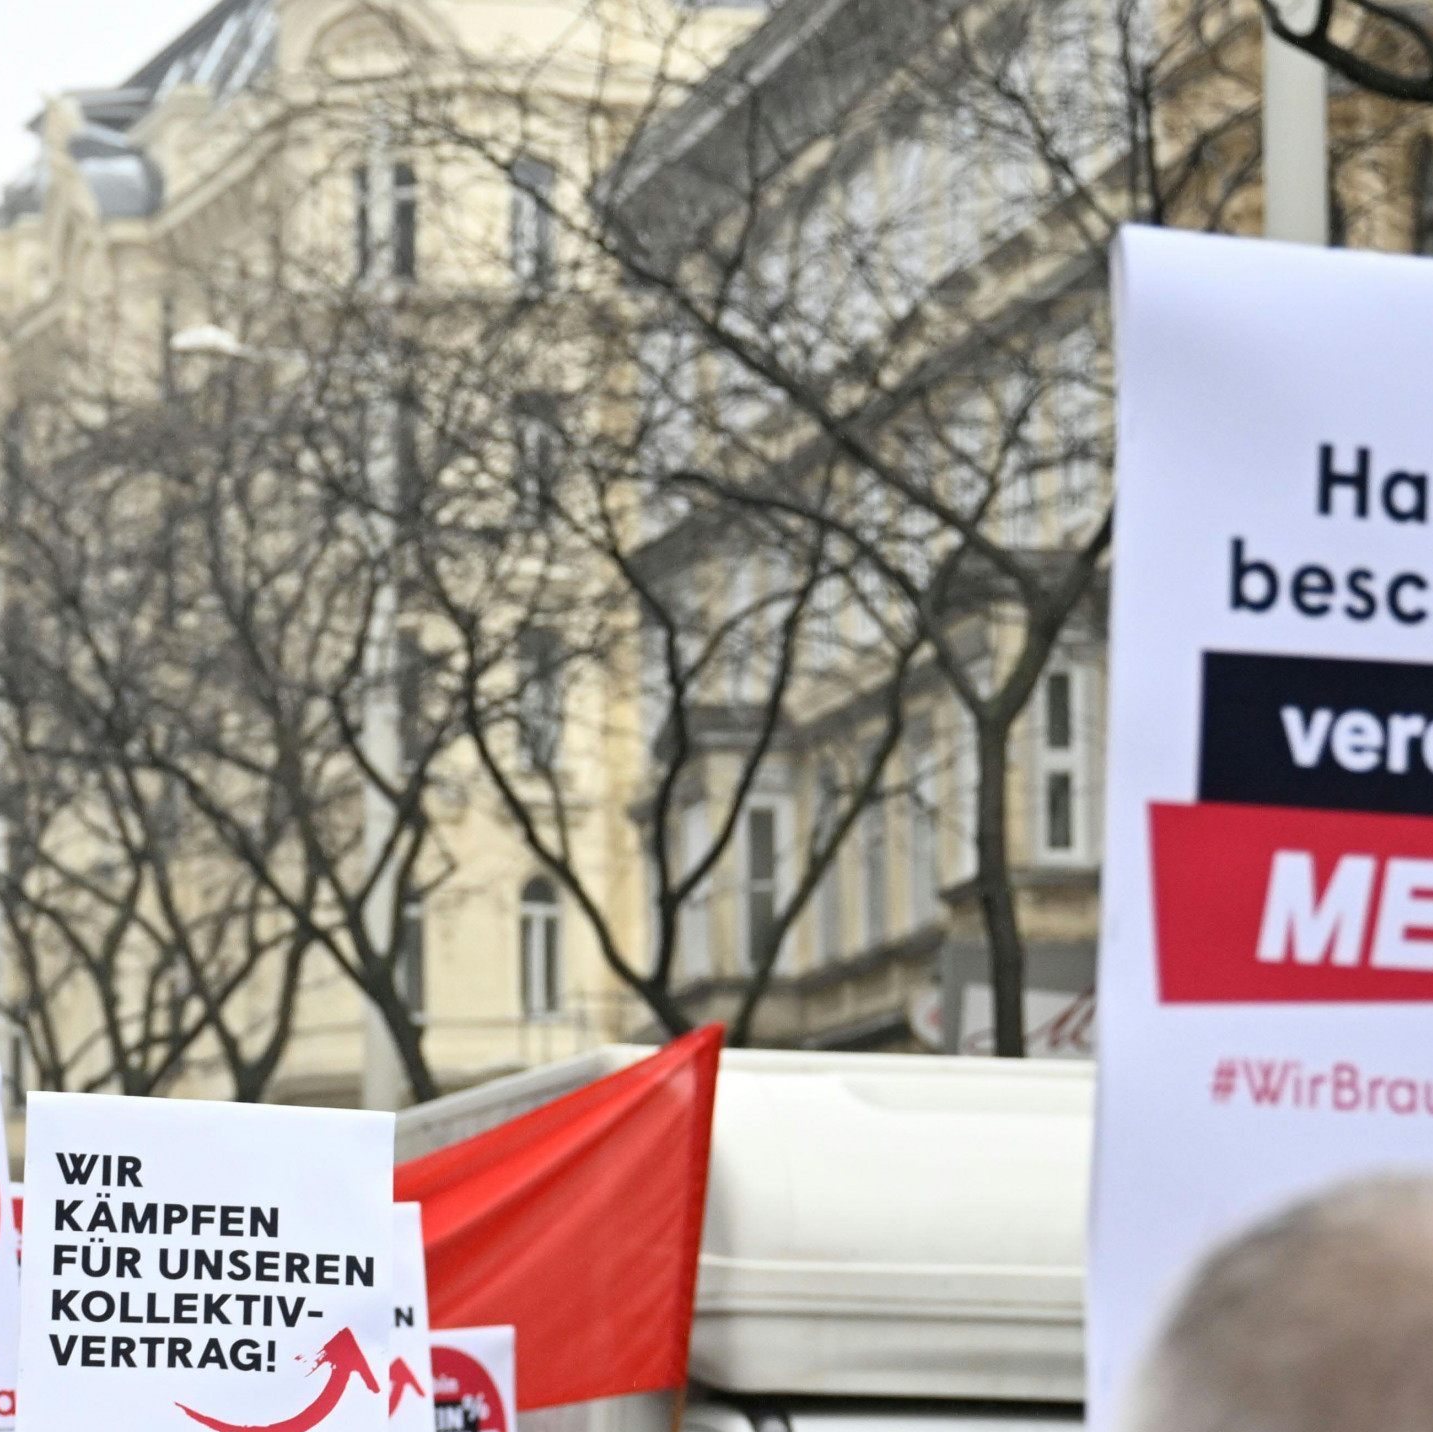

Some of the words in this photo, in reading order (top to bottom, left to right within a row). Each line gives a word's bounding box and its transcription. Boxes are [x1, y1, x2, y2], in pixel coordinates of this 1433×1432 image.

[55, 1152, 144, 1188] WIR
[53, 1193, 280, 1239] KÄMPFEN
[52, 1237, 143, 1280] FÜR
[158, 1248, 375, 1288] UNSEREN
[50, 1289, 324, 1329] KOLLEKTIV-
[49, 1334, 277, 1374] VERTRAG!
